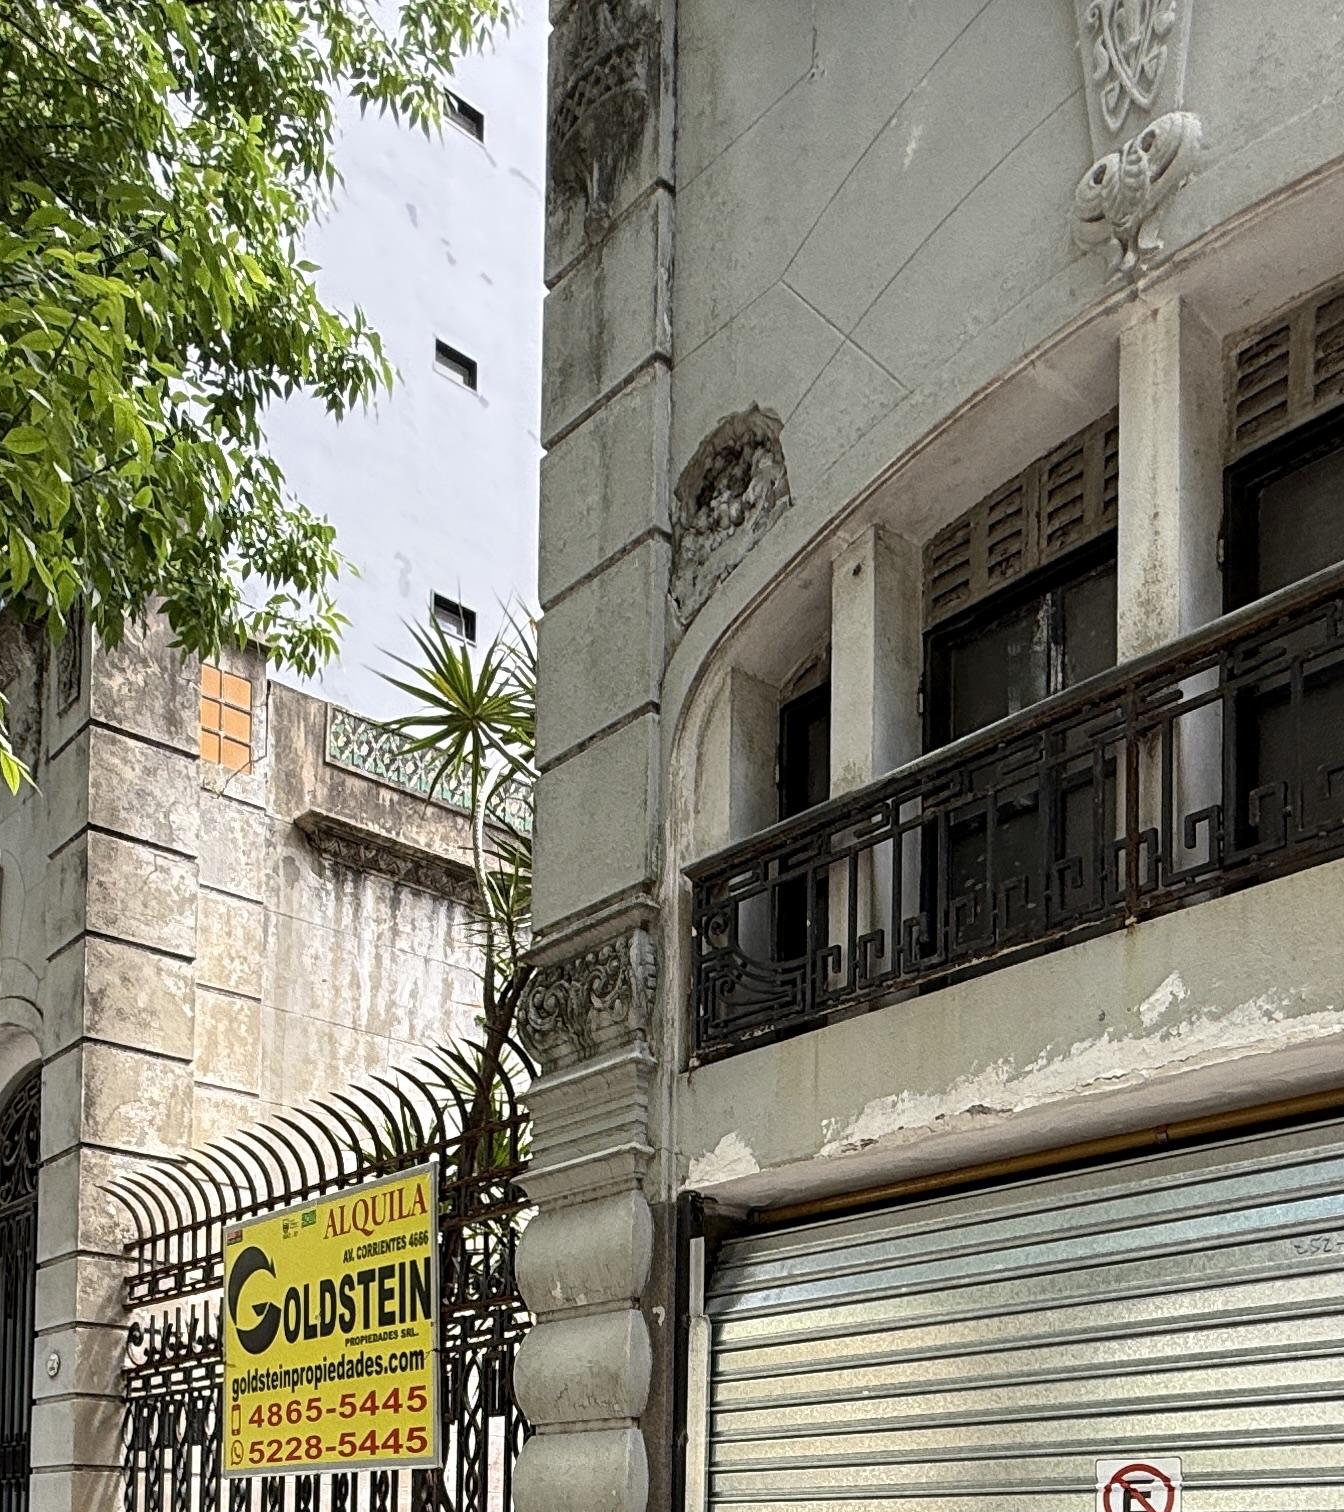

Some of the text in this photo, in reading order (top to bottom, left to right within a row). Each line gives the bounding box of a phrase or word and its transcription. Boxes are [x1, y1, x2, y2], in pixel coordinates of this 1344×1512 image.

[323, 1183, 428, 1240] ALQUILA
[342, 1248, 355, 1264] AV.
[356, 1234, 407, 1261] CORRIENTES
[228, 1246, 432, 1355] GOLDSTEIN
[344, 1329, 399, 1348] PROPIEDADES
[232, 1348, 425, 1402] goldsteinpropiedades.com
[248, 1384, 428, 1429] 4865-5445
[248, 1426, 429, 1465] 5228-5445
